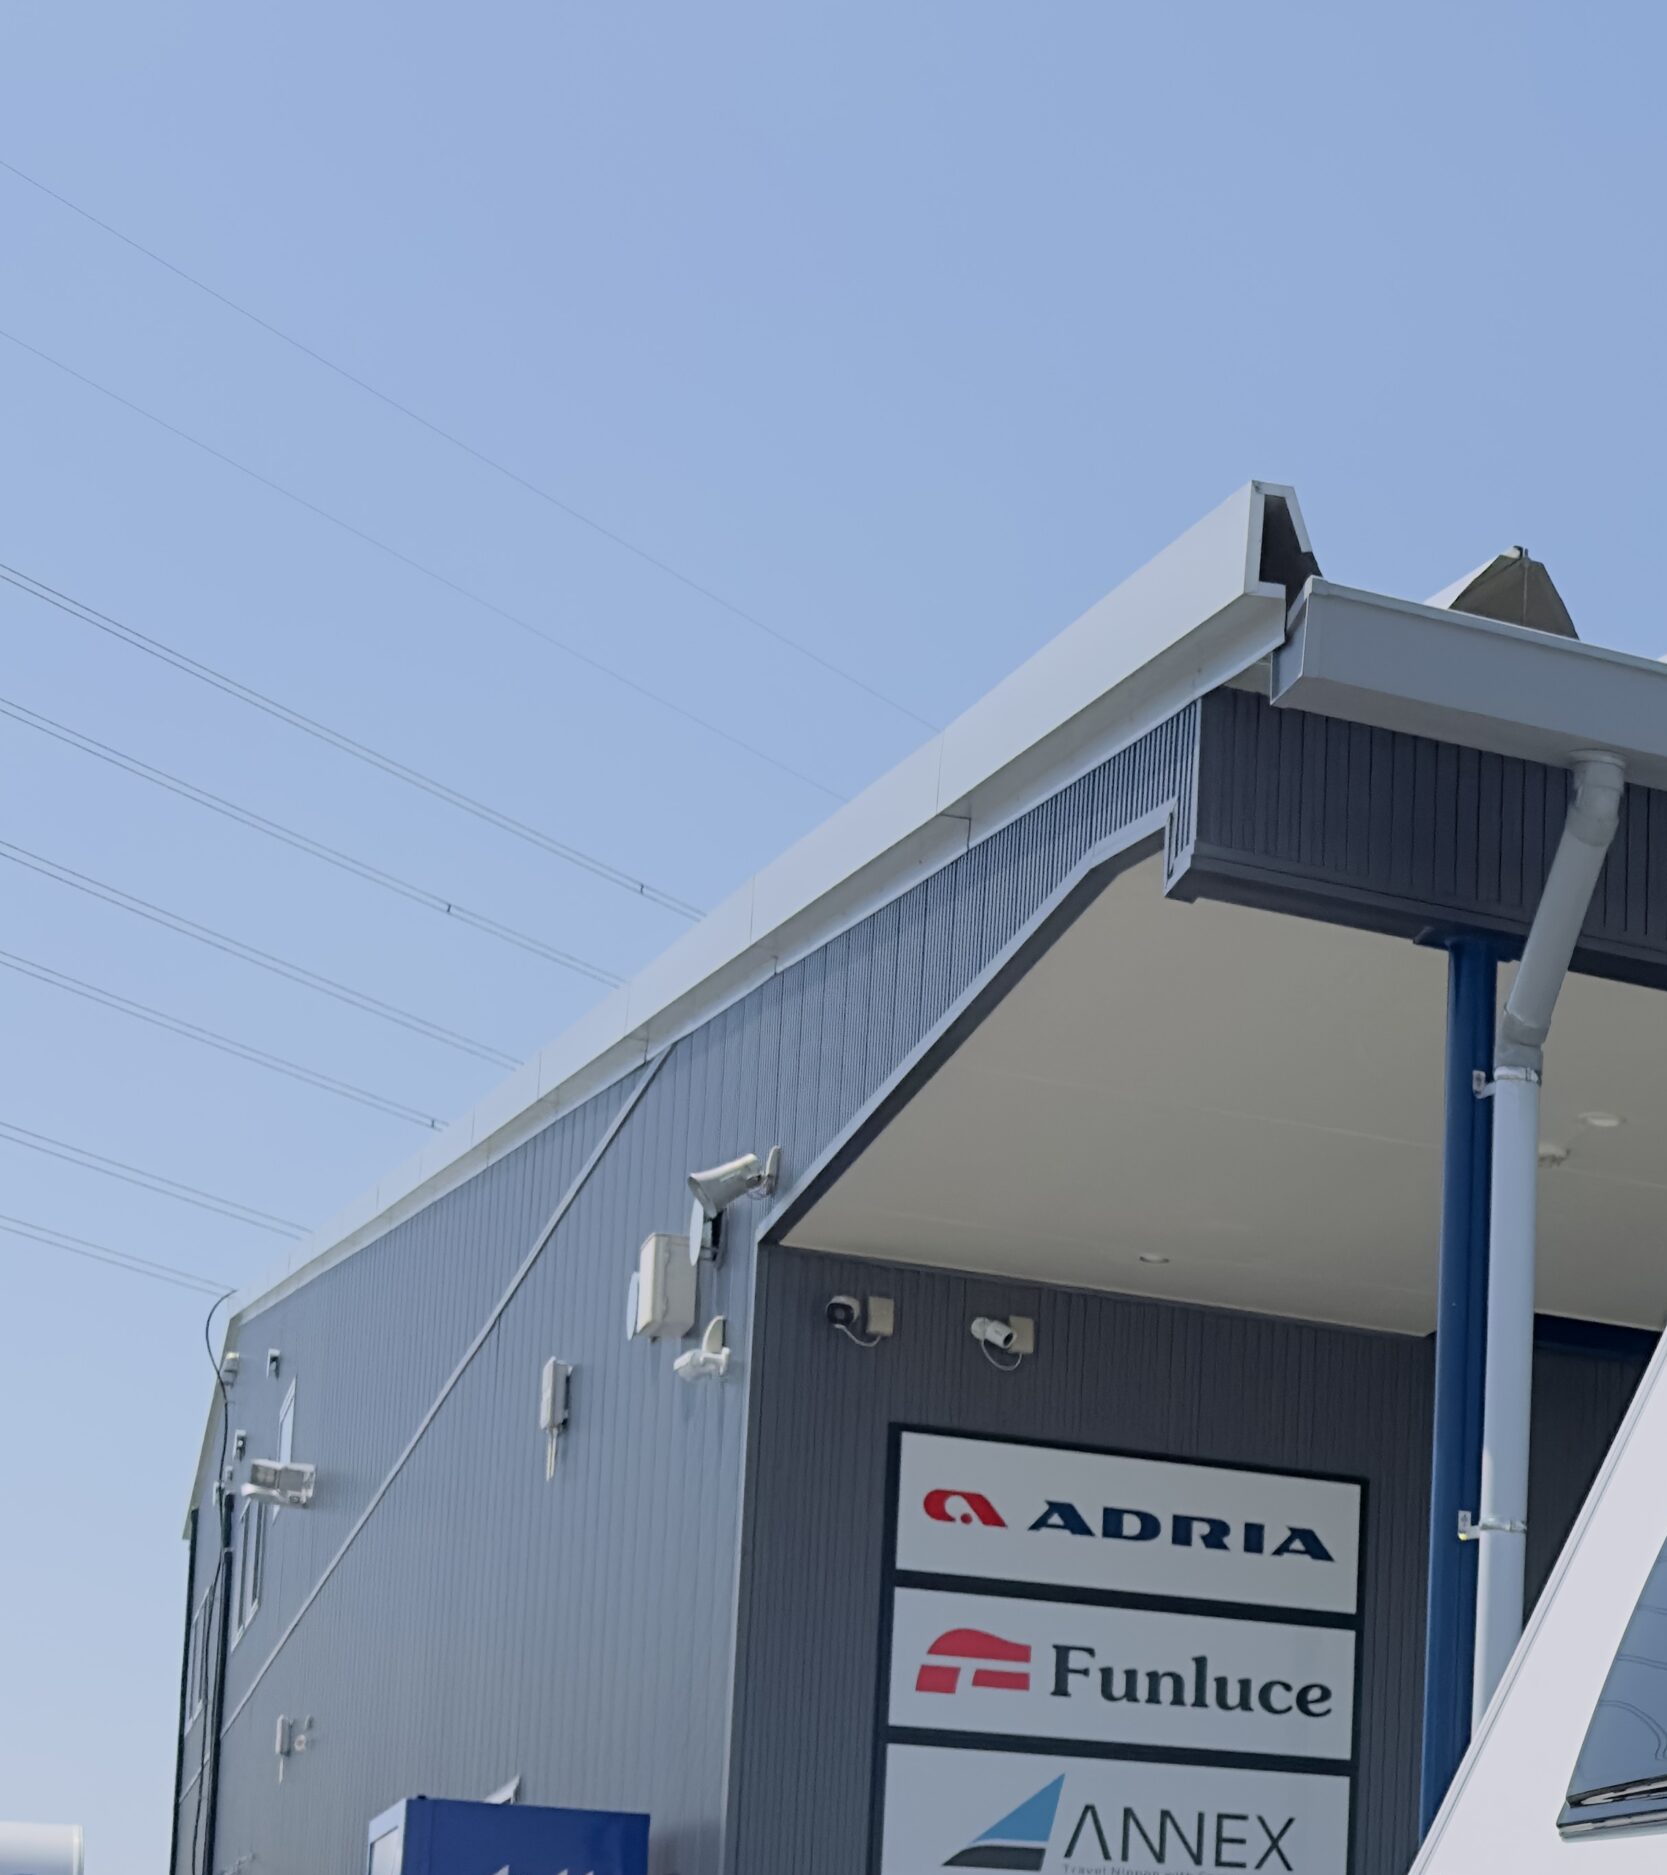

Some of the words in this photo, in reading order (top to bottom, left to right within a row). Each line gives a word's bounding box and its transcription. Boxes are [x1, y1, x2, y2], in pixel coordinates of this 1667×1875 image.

[1027, 1500, 1335, 1562] ADRIA
[1050, 1643, 1333, 1718] Funluce
[1063, 1803, 1295, 1872] ANNEX
[1063, 1864, 1107, 1875] Travel
